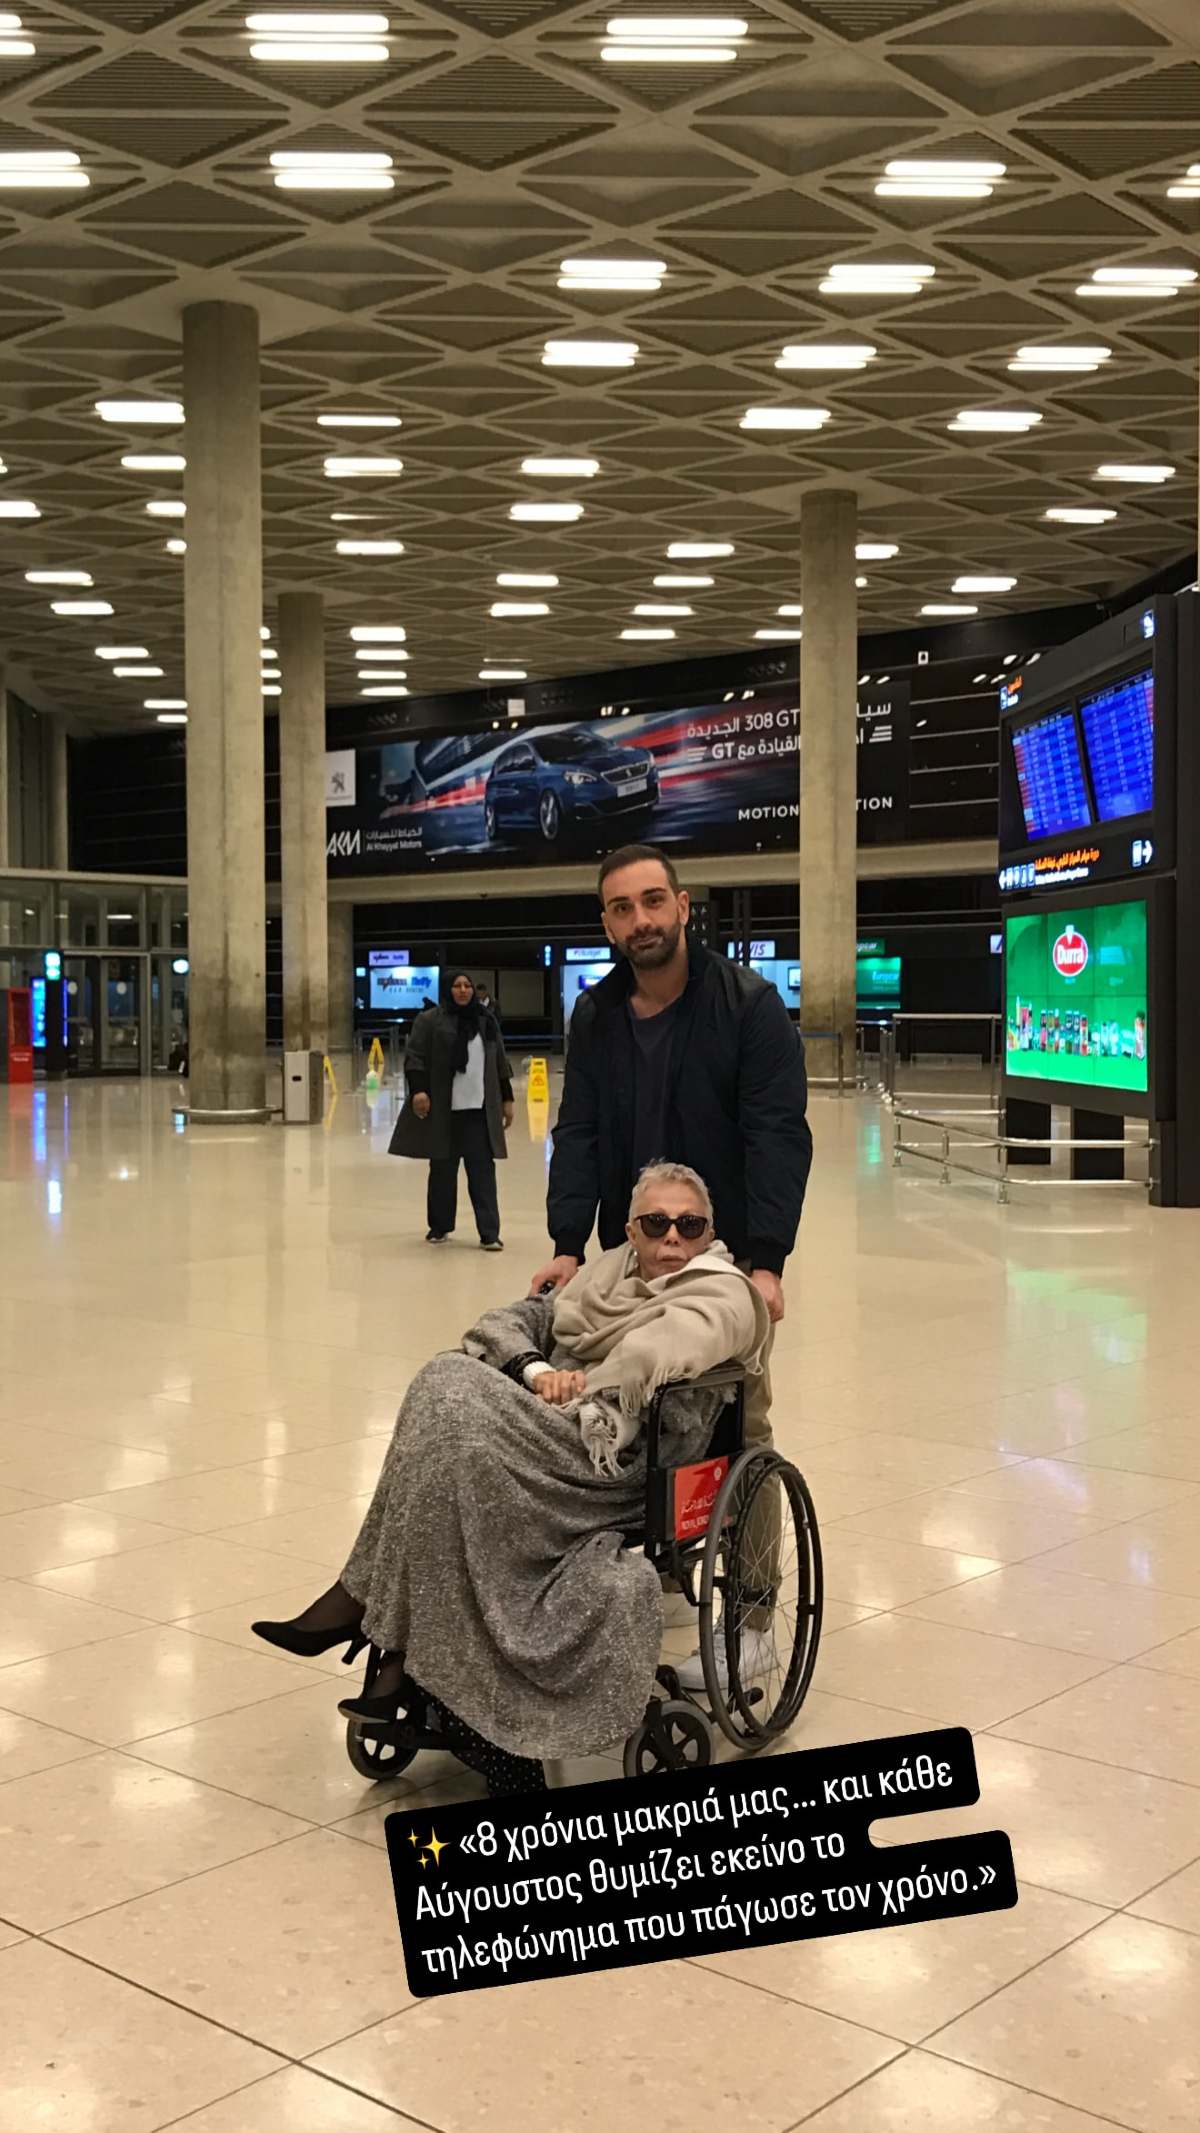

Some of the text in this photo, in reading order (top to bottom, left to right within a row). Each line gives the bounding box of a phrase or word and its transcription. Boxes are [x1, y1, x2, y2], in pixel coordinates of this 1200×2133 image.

[687, 702, 892, 740] سيا 308 GT الجديدة
[712, 742, 735, 760] GT
[738, 744, 754, 760] مع
[738, 796, 893, 821] MOTION TION
